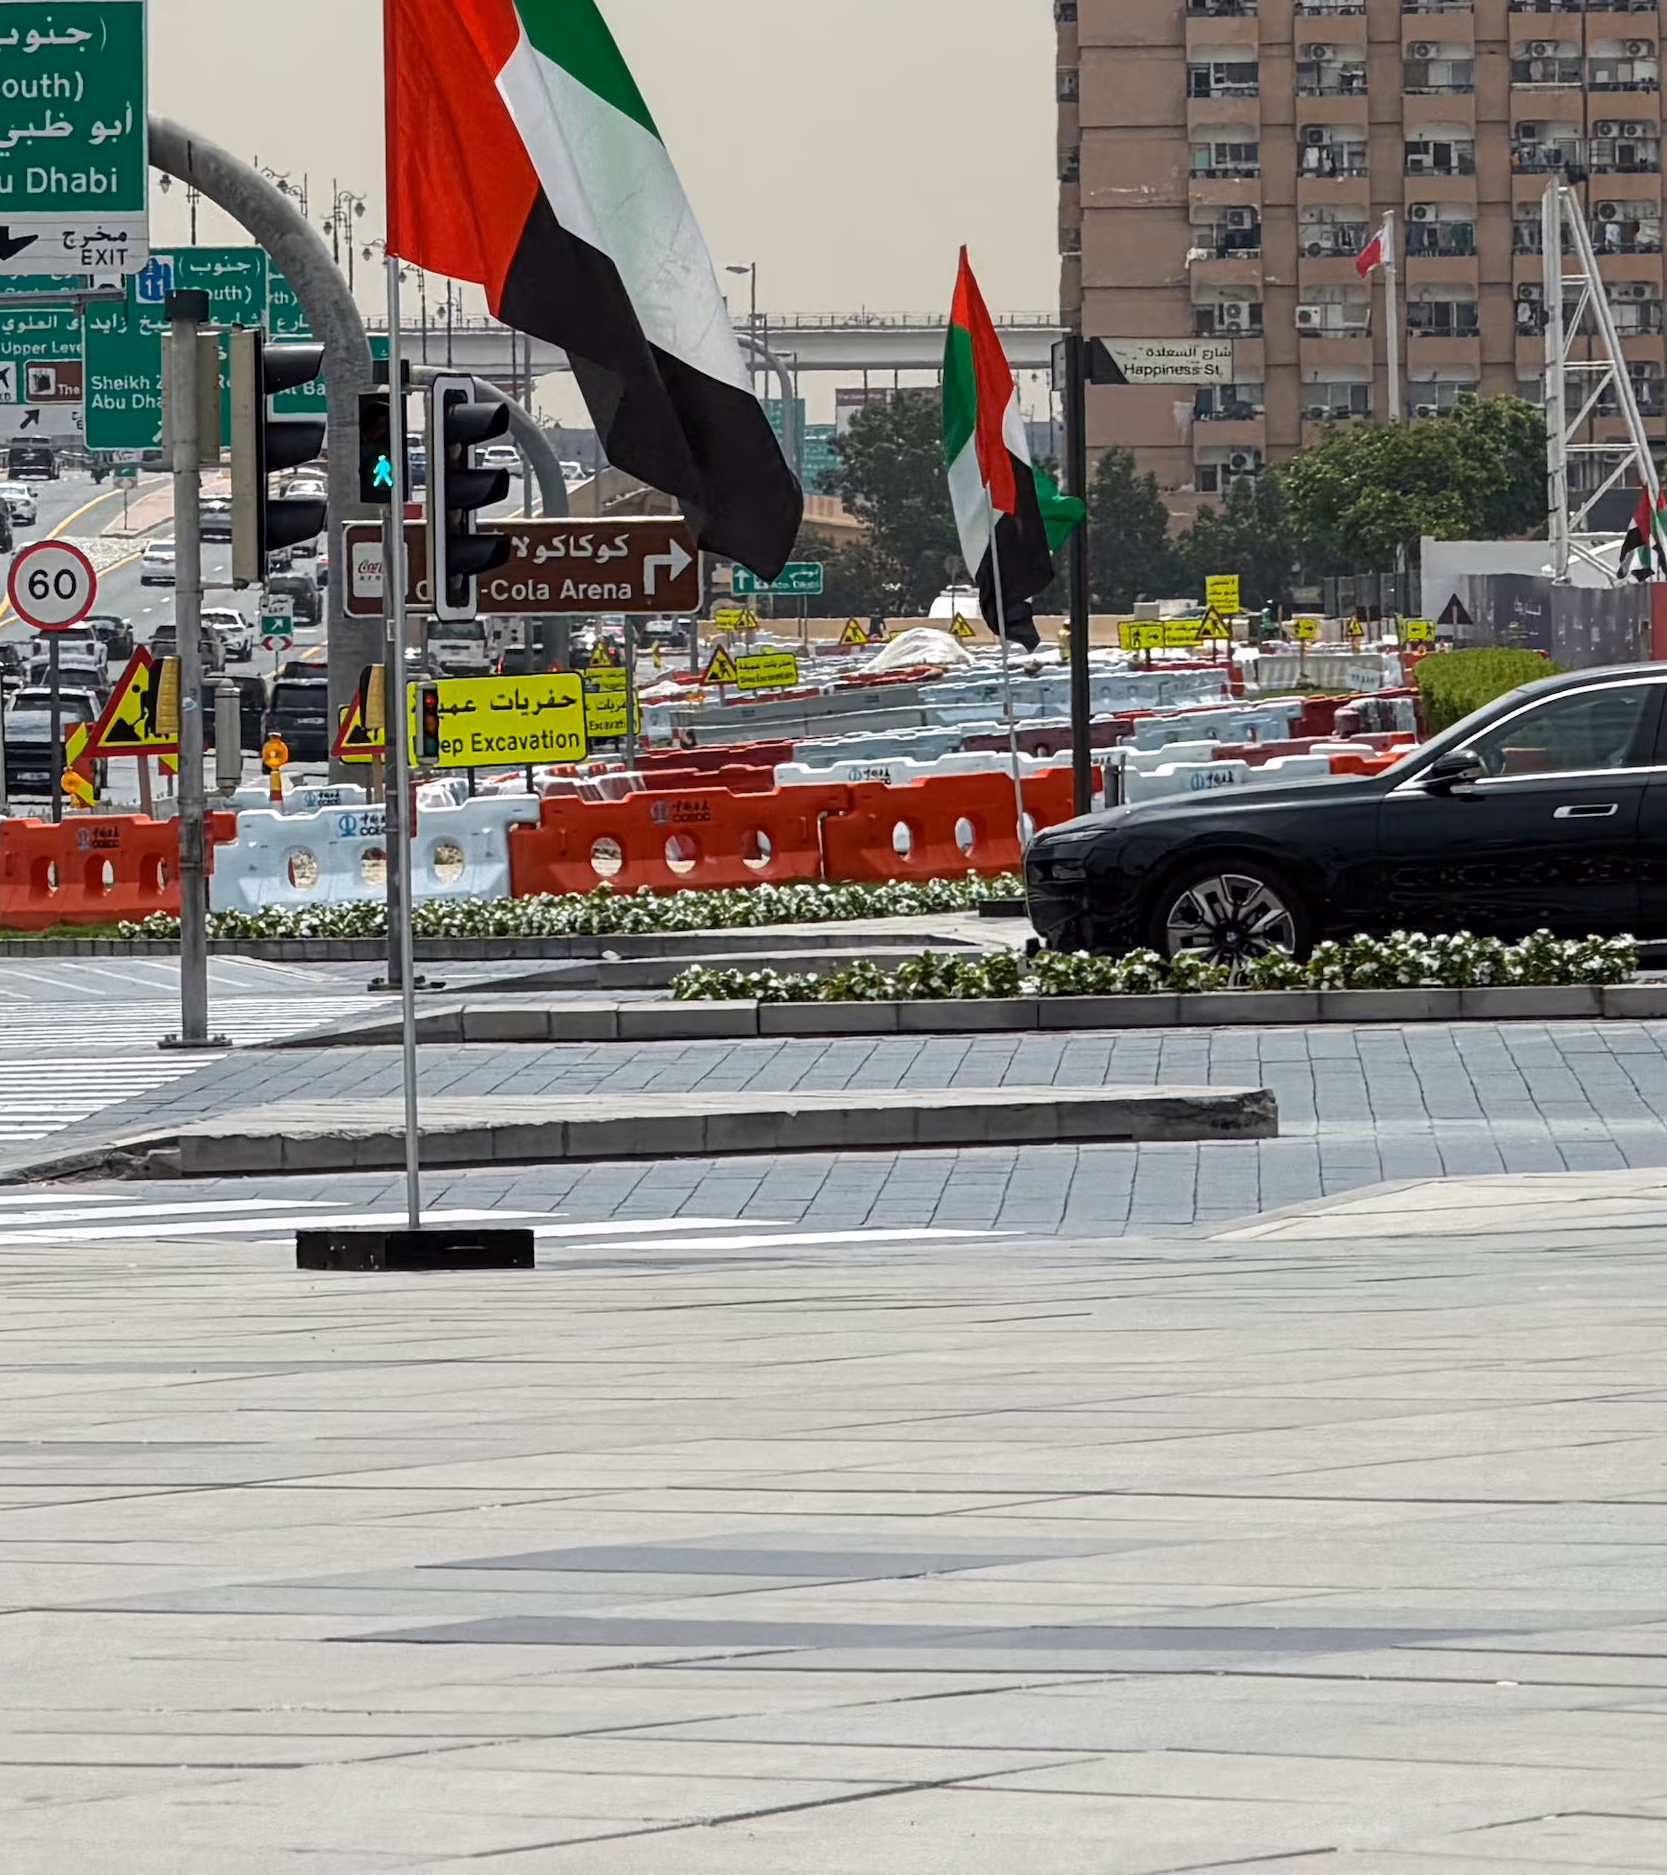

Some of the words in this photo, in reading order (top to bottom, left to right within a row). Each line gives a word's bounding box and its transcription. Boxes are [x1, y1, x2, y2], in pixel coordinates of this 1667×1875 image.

[88, 101, 134, 145] أبو
[27, 166, 119, 195] Dhabi
[61, 226, 129, 251] مخرج
[80, 248, 130, 267] EXIT
[90, 374, 151, 391] Sheikh
[1123, 363, 1200, 378] Happiness
[91, 393, 126, 410] Abu
[28, 568, 77, 600] 60
[559, 578, 633, 601] Arena
[489, 688, 578, 716] حفريات
[471, 729, 580, 753] Excavation
